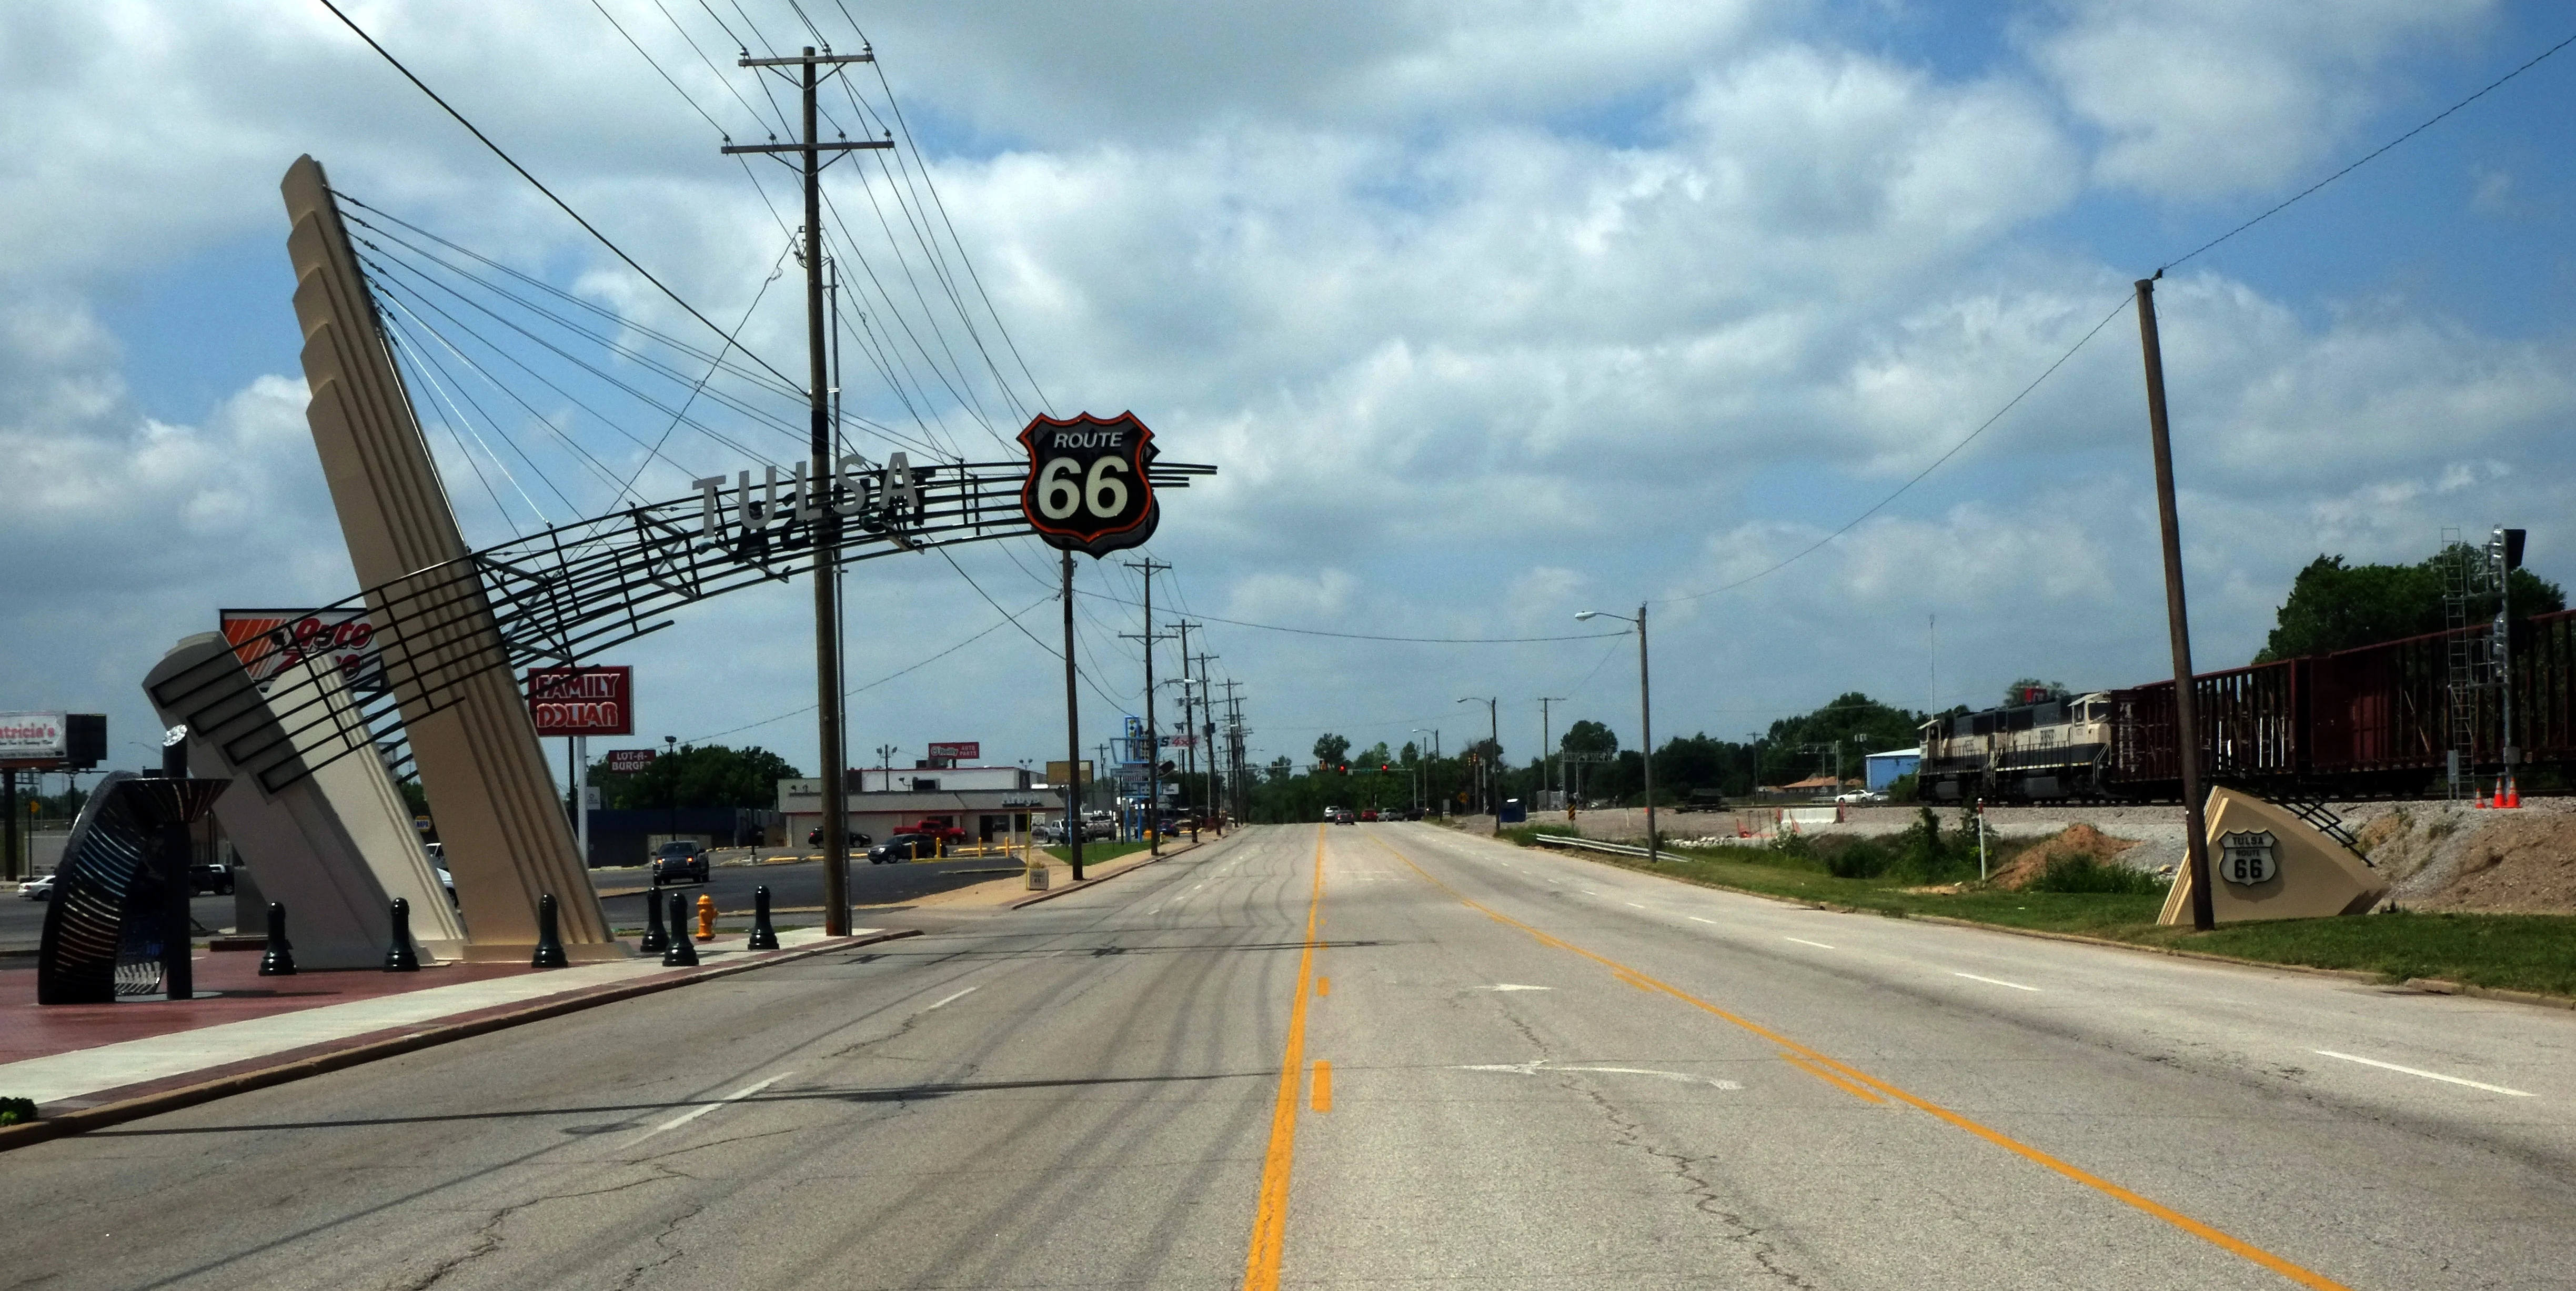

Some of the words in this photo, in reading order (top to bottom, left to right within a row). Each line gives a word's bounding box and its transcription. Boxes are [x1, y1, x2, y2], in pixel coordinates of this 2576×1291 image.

[1053, 432, 1124, 448] ROUTE
[687, 451, 919, 539] TULSA
[1038, 455, 1129, 520] 66
[536, 673, 620, 699] FAMILY
[537, 702, 619, 728] DOLLAR
[2232, 836, 2263, 845] TULSA
[2235, 859, 2262, 879] 66
